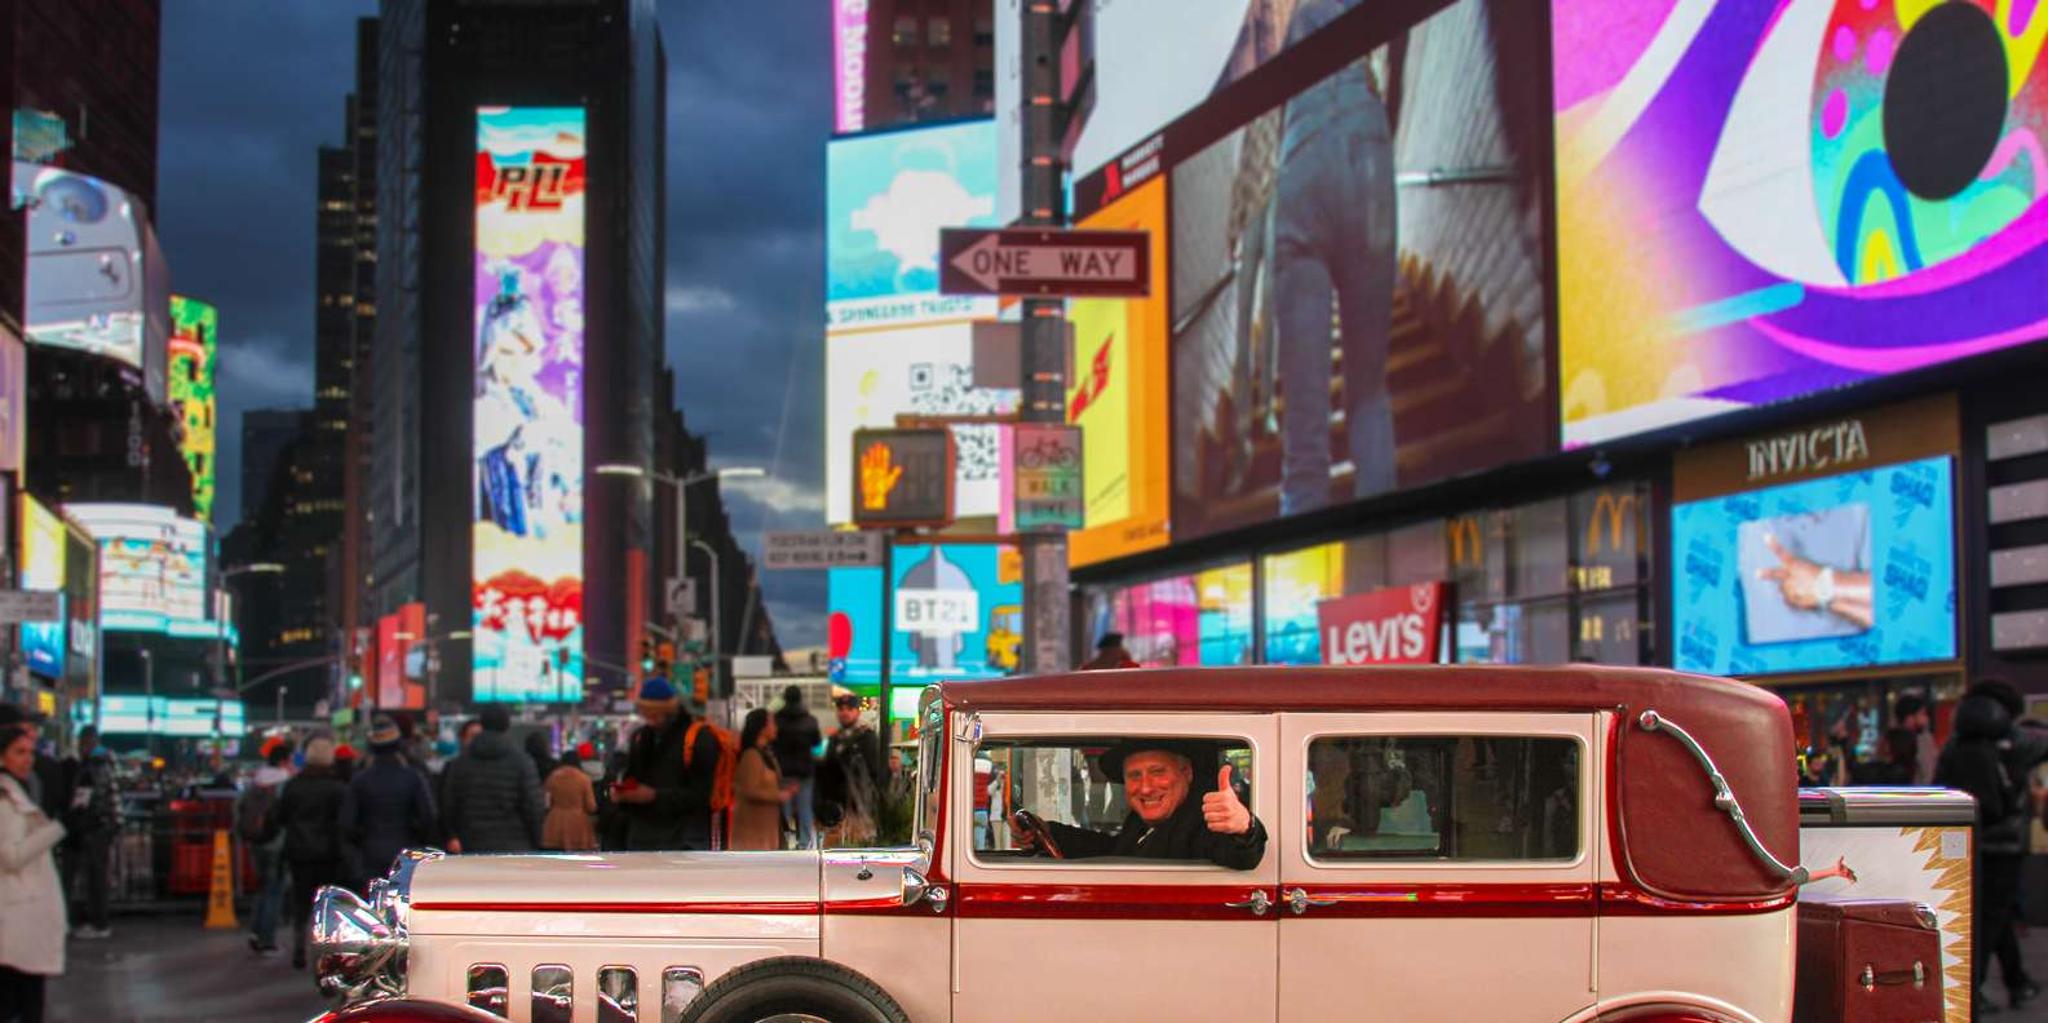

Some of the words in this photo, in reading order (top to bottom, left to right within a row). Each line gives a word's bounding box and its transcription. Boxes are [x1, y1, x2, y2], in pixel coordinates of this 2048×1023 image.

[972, 250, 1030, 275] ONE
[1060, 251, 1123, 275] WAY
[1747, 419, 1869, 480] INVICTA
[905, 599, 968, 622] BT21
